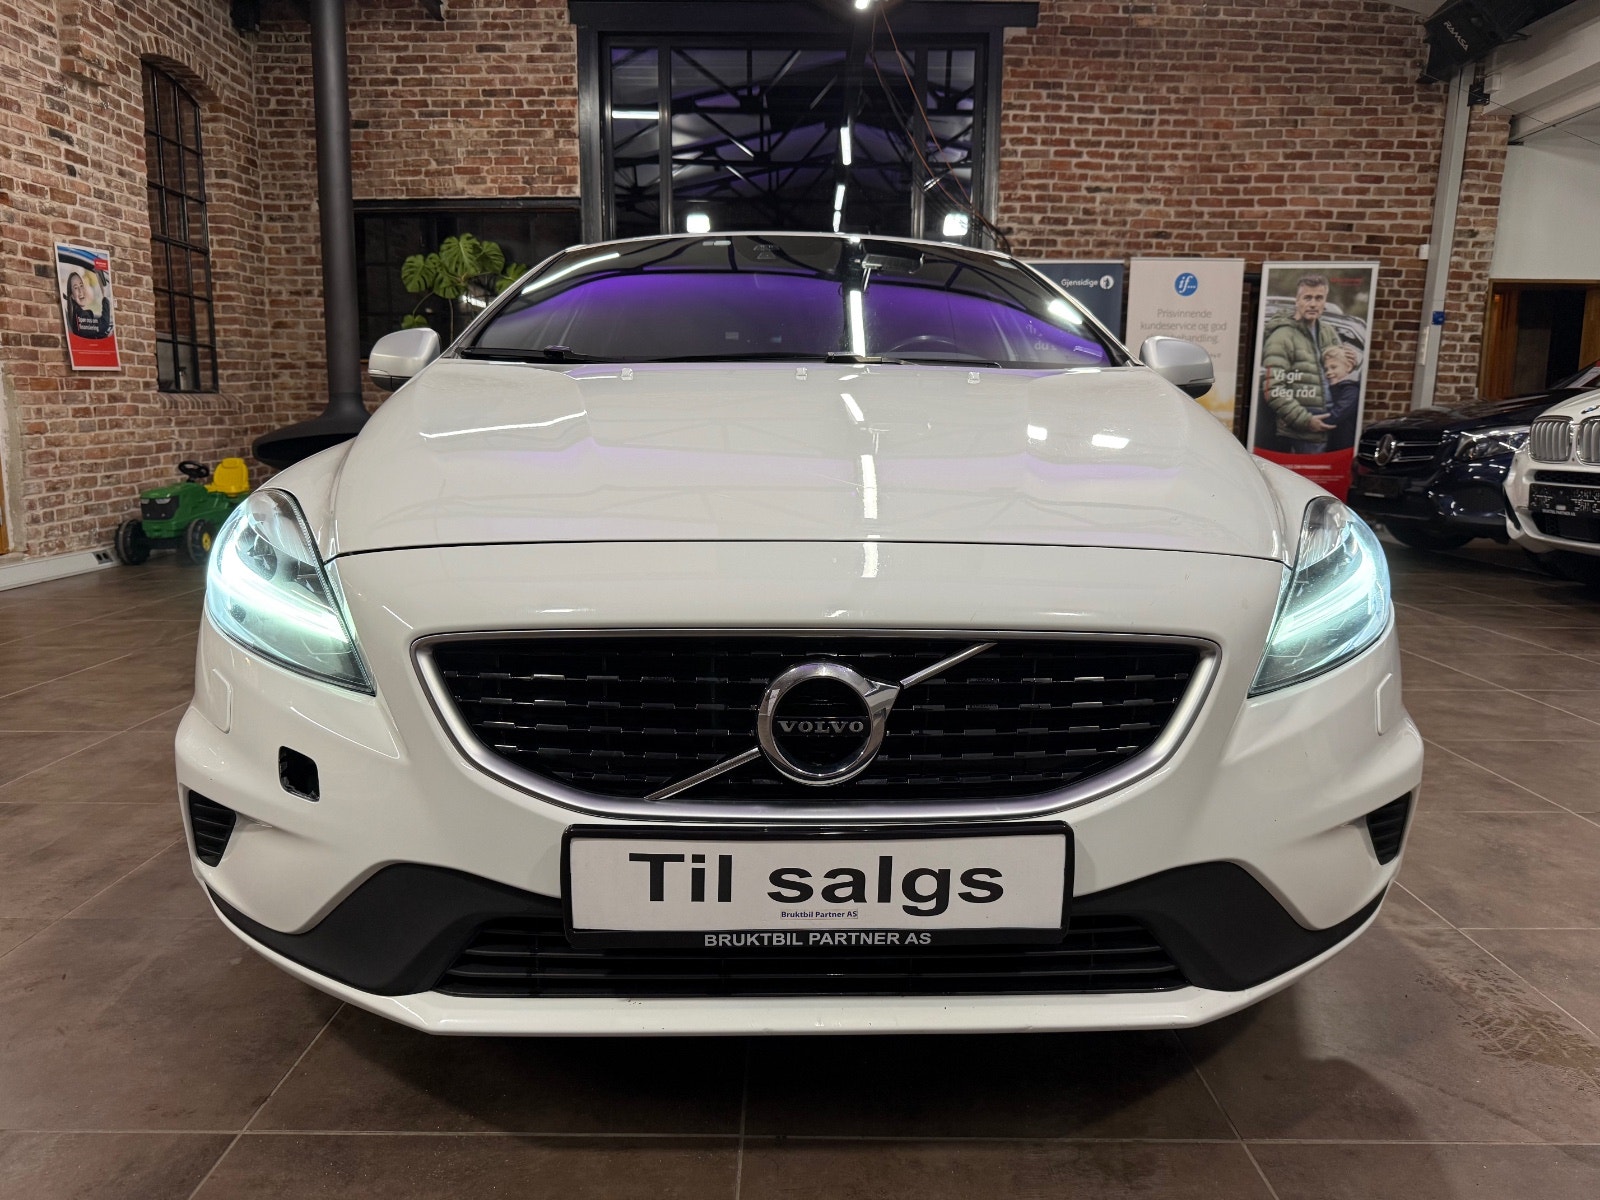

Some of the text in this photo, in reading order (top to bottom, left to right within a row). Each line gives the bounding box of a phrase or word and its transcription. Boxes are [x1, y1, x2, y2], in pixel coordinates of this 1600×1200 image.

[1060, 278, 1099, 288] Gjensidige
[1156, 308, 1212, 318] Prisvinnende
[1140, 321, 1227, 332] kundeservice og god
[1273, 368, 1304, 384] Vi gir
[1271, 385, 1317, 401] deg råd
[777, 720, 865, 734] VOLVO
[628, 852, 1005, 917] Til salgs
[780, 910, 859, 918] Bruktbil Partner AS
[704, 932, 932, 947] BRUKTBIL PARTNER AS
